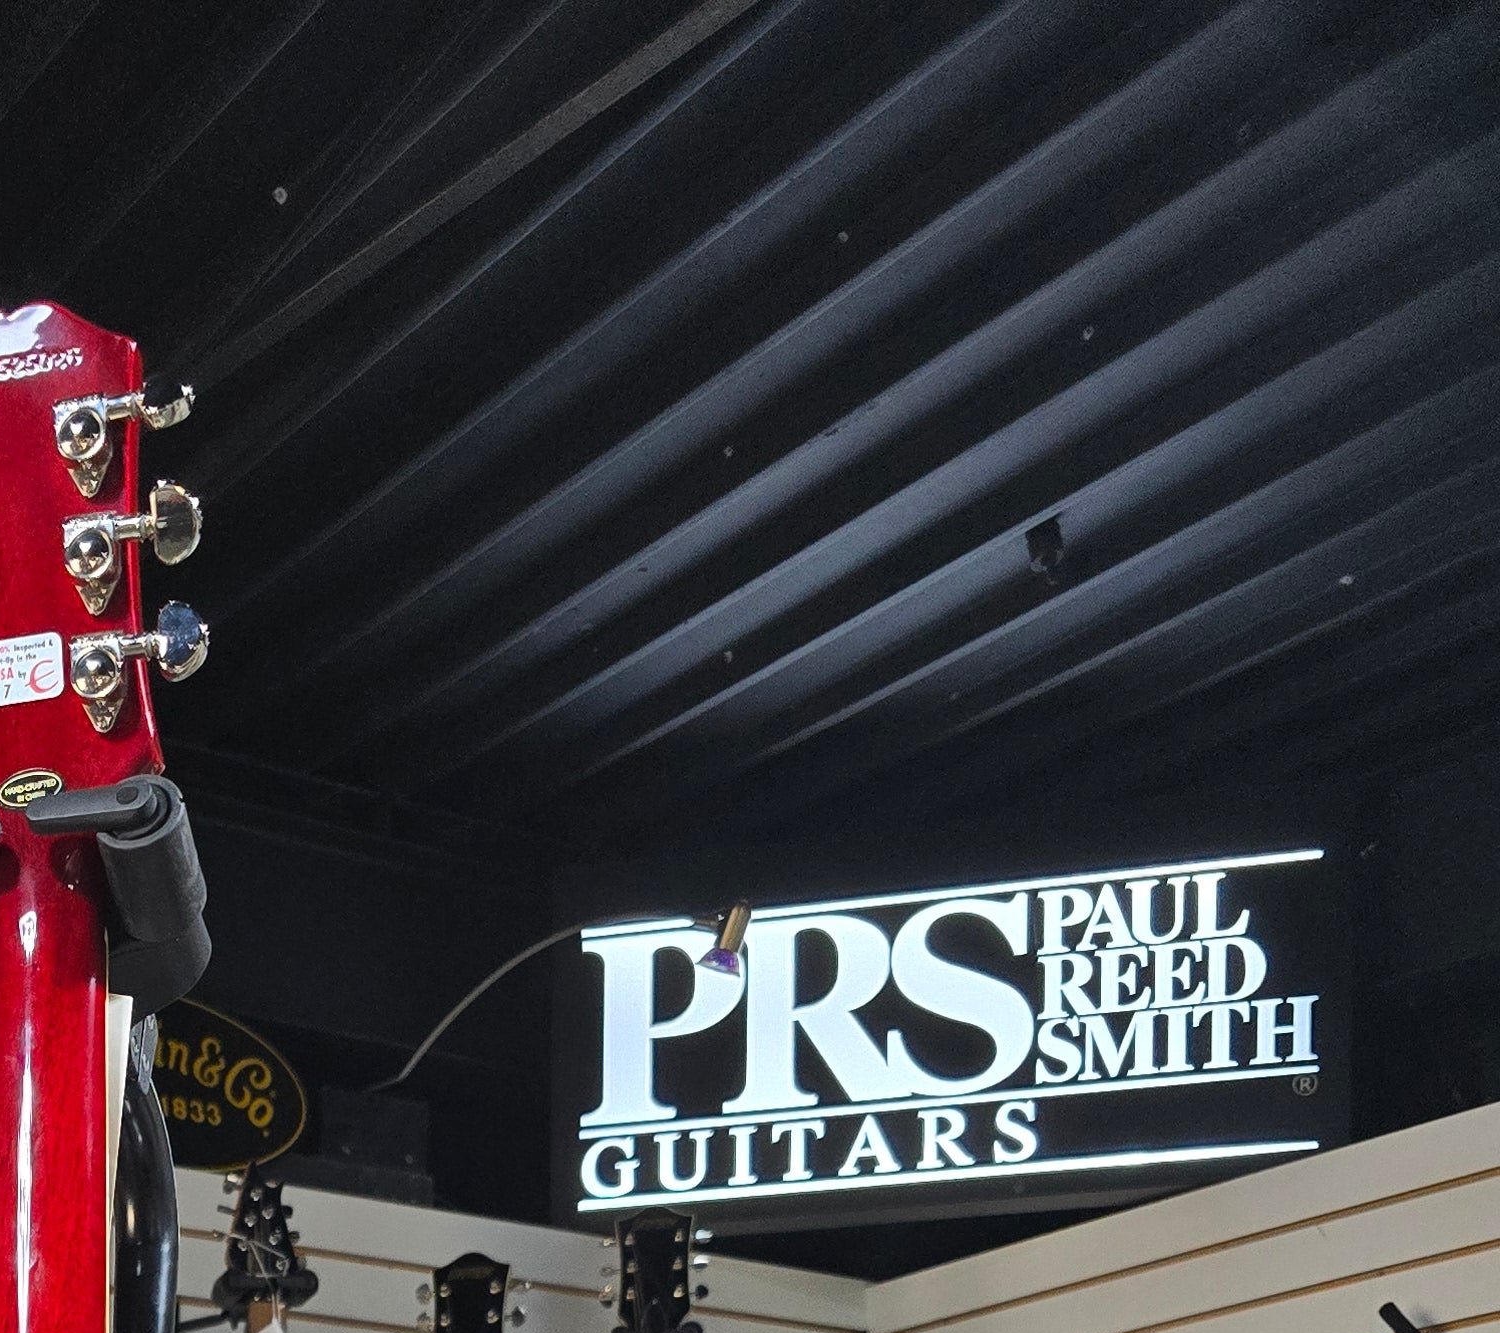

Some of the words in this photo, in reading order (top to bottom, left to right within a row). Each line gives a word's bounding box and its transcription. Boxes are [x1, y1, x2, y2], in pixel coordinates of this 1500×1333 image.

[14, 640, 45, 652] Inspected
[26, 653, 37, 661] the
[4, 684, 11, 699] 7
[18, 671, 27, 680] by
[1036, 872, 1250, 956] PAUL
[1036, 937, 1268, 1020] REED
[581, 890, 1034, 1127] PRS
[1034, 994, 1320, 1086] SMITH
[161, 1095, 222, 1126] 1833
[580, 1099, 1037, 1199] GUITARS
